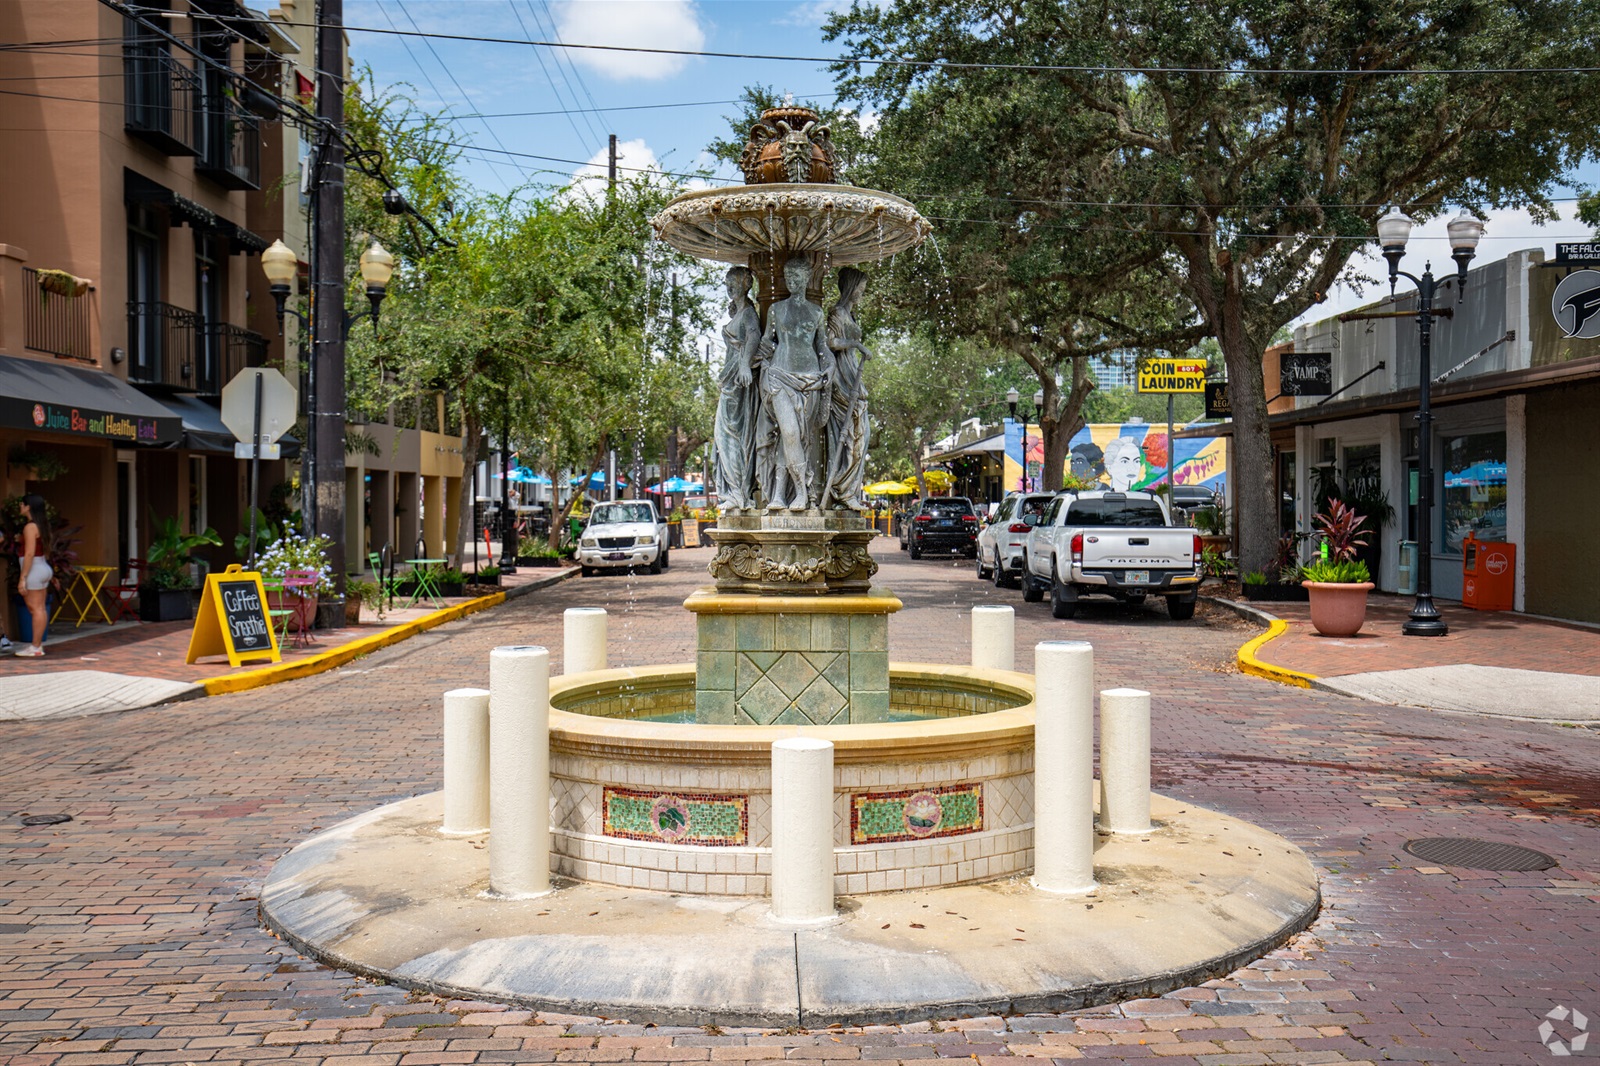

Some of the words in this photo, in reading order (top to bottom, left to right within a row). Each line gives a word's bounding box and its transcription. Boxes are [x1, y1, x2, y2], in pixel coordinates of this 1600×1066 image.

[1561, 244, 1578, 253] THE
[1142, 362, 1175, 375] COIN
[1294, 366, 1319, 379] VAMP
[1141, 377, 1203, 390] LAUNDRY
[46, 406, 69, 429] Juice
[71, 409, 87, 431] Bar
[89, 415, 105, 435] and
[106, 414, 137, 440] Healthy
[138, 419, 158, 440] Eats!
[229, 614, 267, 638] Smoothie
